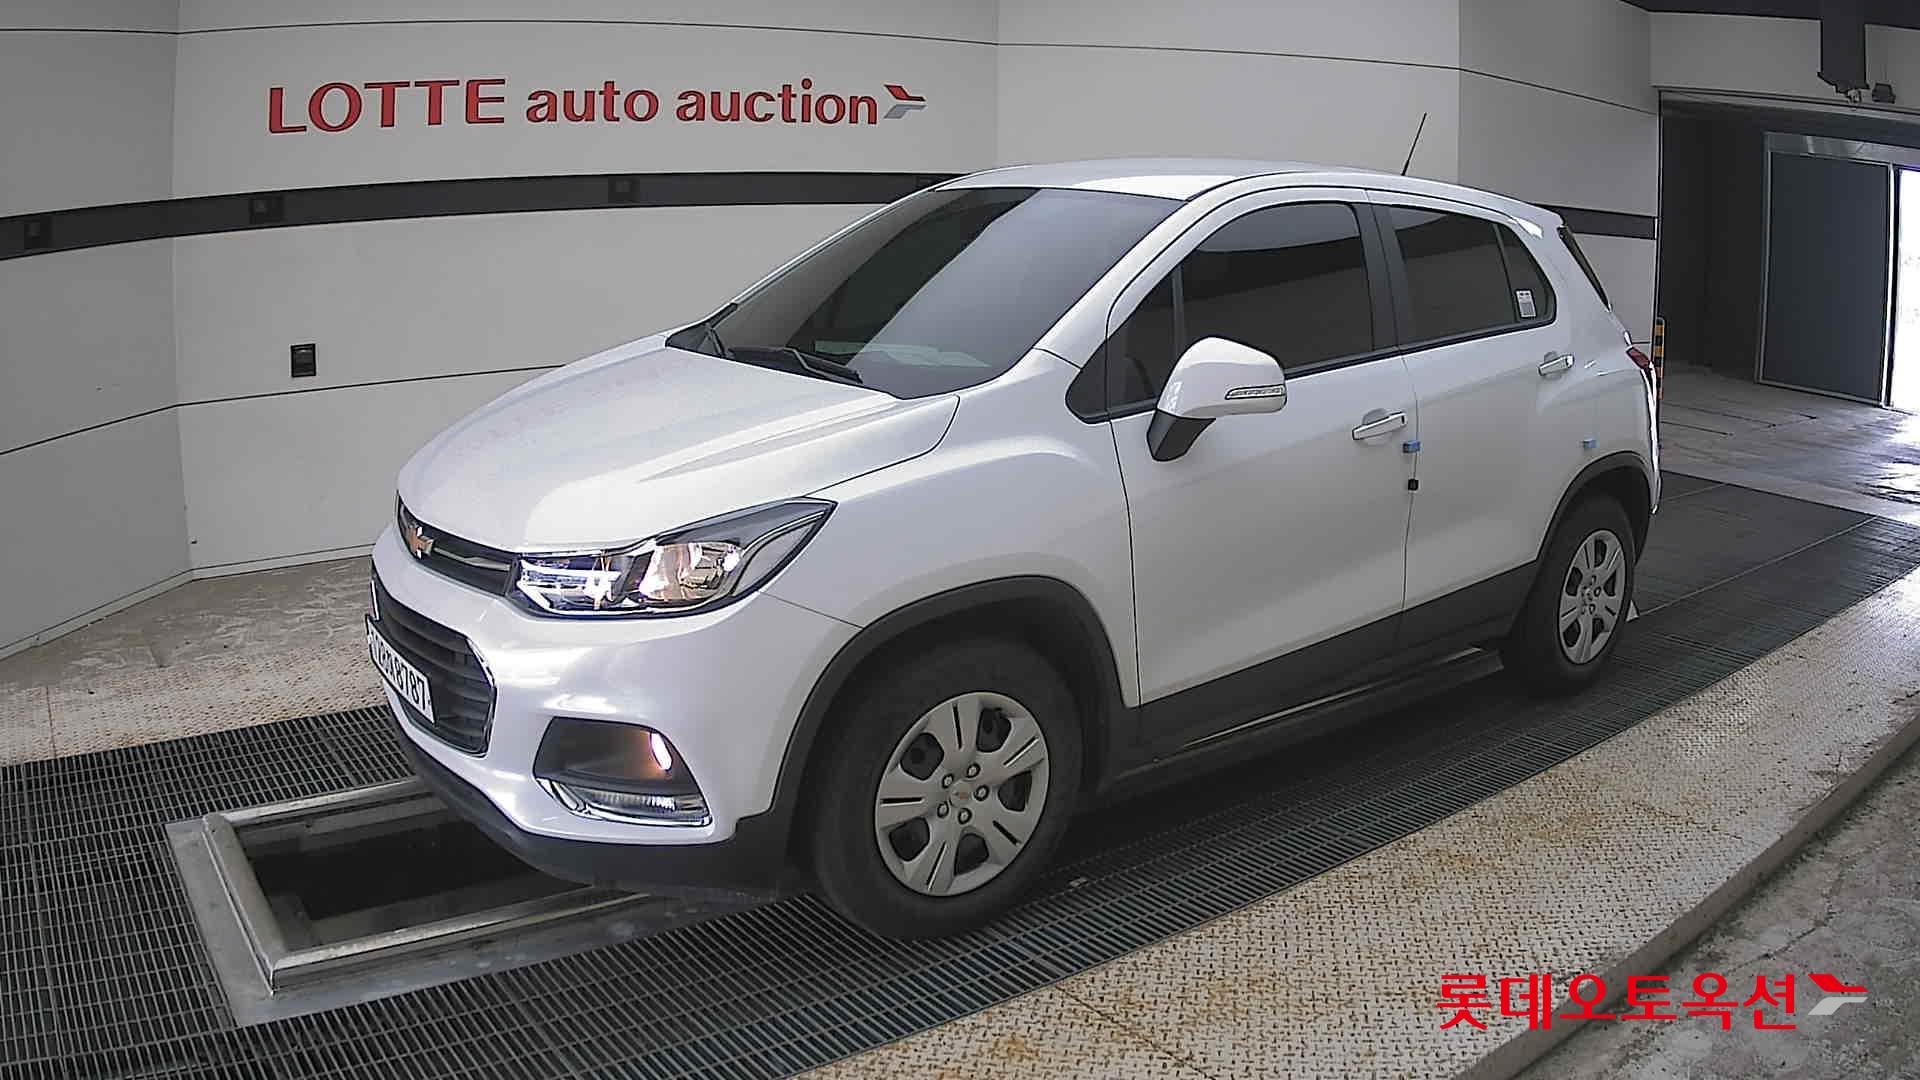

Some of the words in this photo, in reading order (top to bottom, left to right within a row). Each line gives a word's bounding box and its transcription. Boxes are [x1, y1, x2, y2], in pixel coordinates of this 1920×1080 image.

[268, 78, 506, 134] LOTTE
[526, 80, 659, 124] auto
[675, 78, 878, 125] auction
